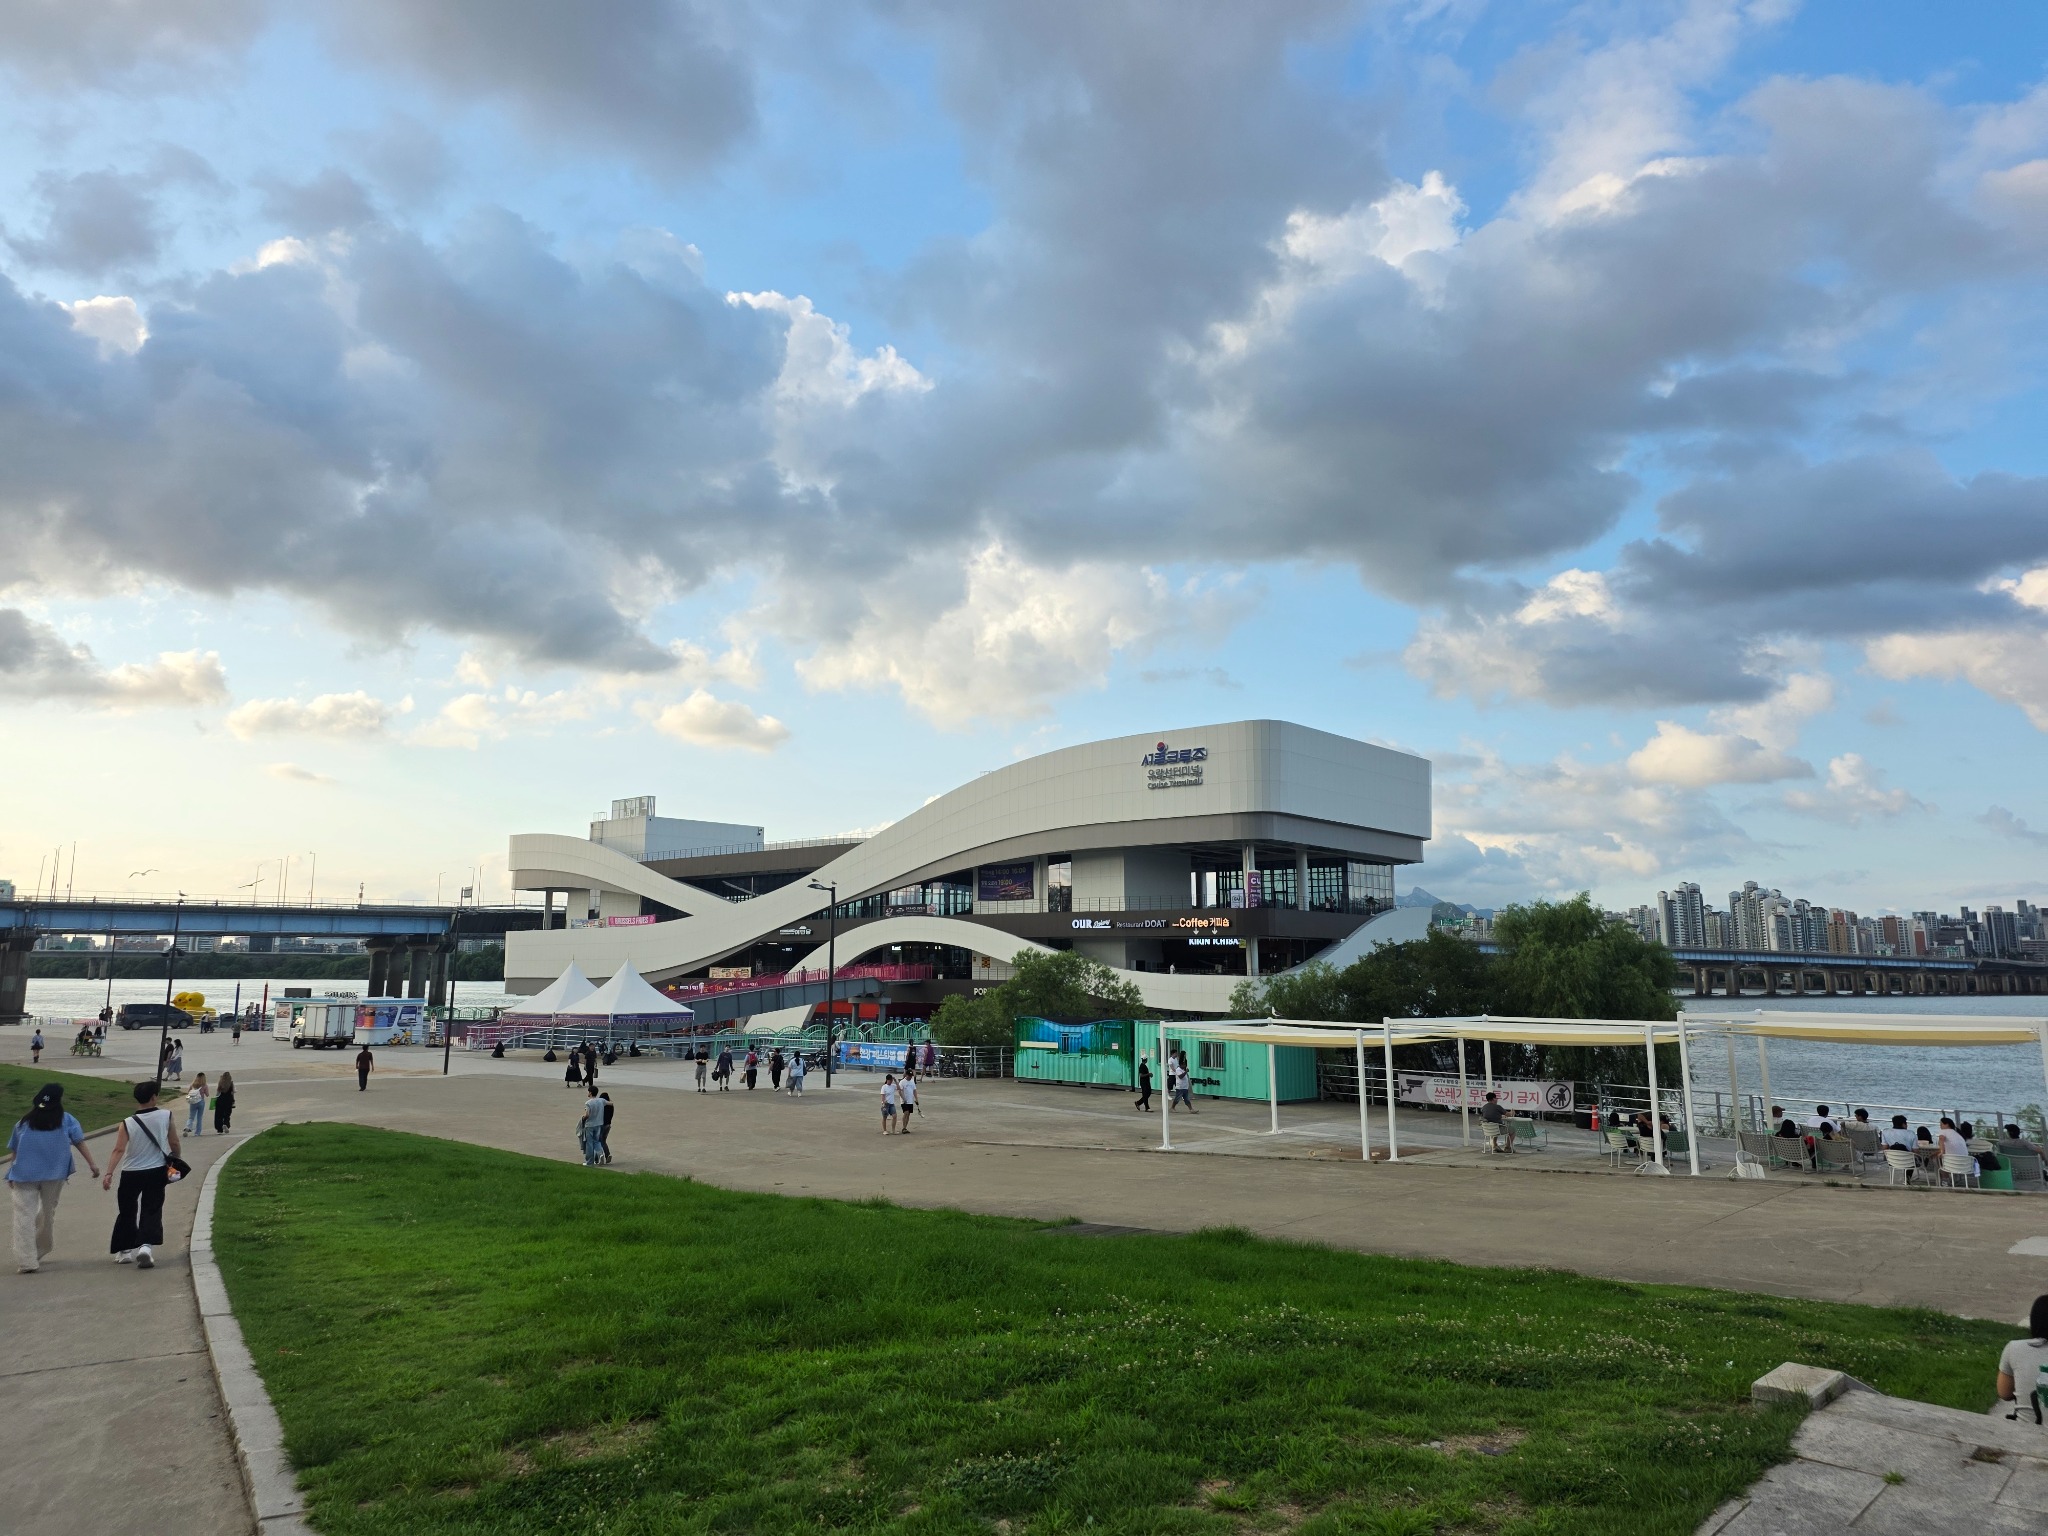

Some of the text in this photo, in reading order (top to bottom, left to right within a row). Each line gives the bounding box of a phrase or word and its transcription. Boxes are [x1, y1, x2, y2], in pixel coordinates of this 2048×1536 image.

[1141, 742, 1207, 766] 서울크루즈
[1147, 765, 1203, 780] 유람선터미널
[1147, 778, 1203, 789] Cruise Terminal
[1071, 919, 1092, 929] OUR
[1144, 919, 1167, 928] DOAT
[1179, 917, 1230, 928] Coffee 커피숍
[1207, 1078, 1221, 1086] Bus
[1517, 1091, 1540, 1105] 금지
